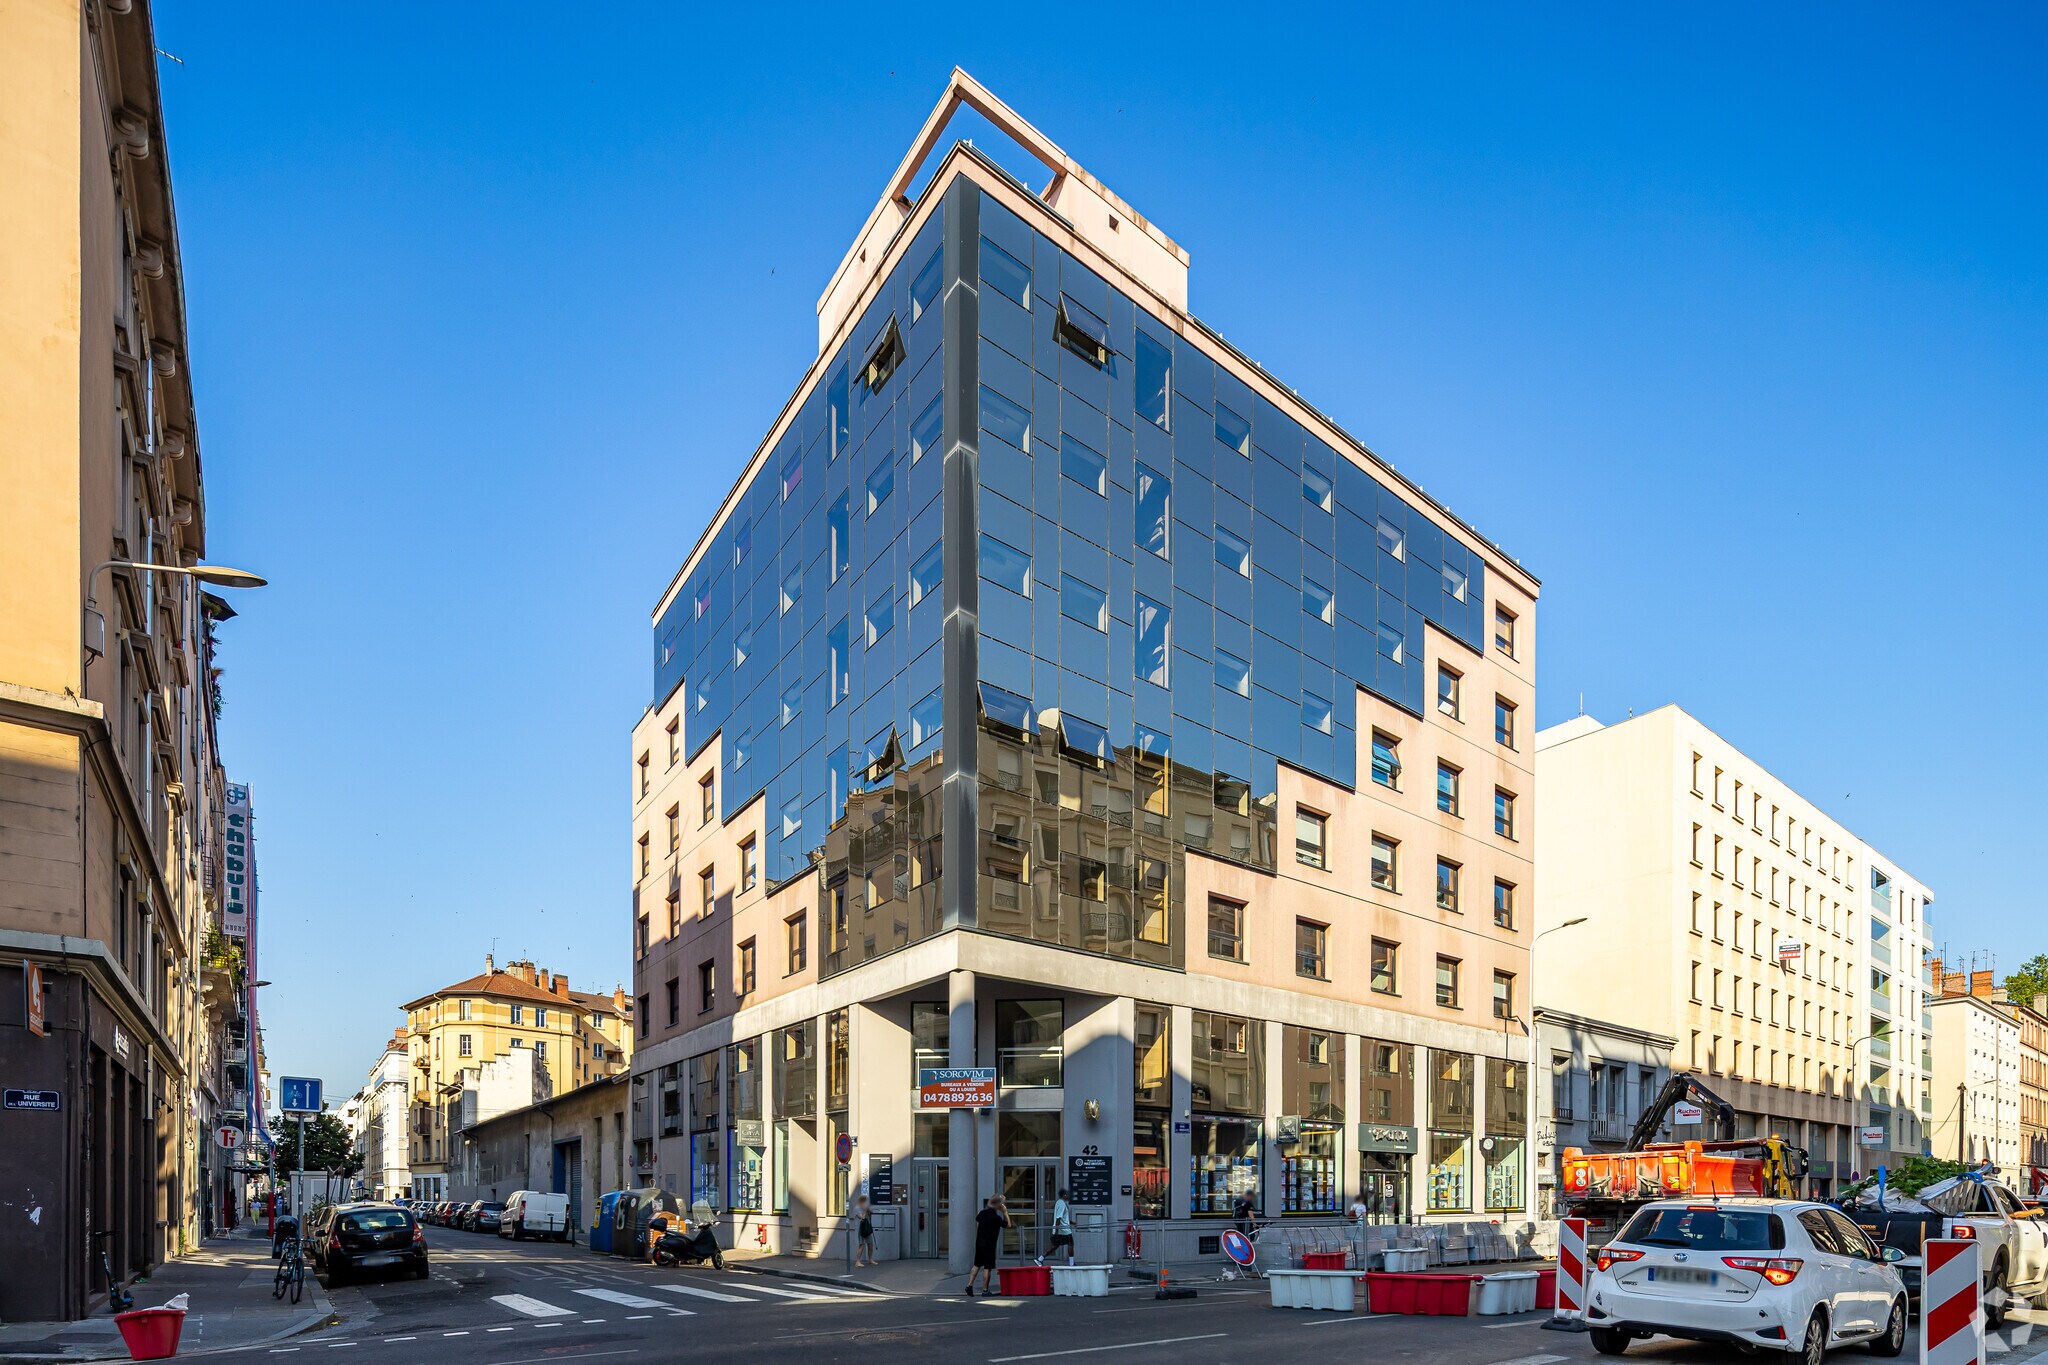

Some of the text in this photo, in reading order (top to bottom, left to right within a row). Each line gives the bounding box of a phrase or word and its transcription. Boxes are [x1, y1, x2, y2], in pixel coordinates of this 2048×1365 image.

[227, 814, 244, 914] thabuis
[923, 1092, 993, 1102] 04 78 89 26 36
[1082, 1145, 1099, 1156] 42
